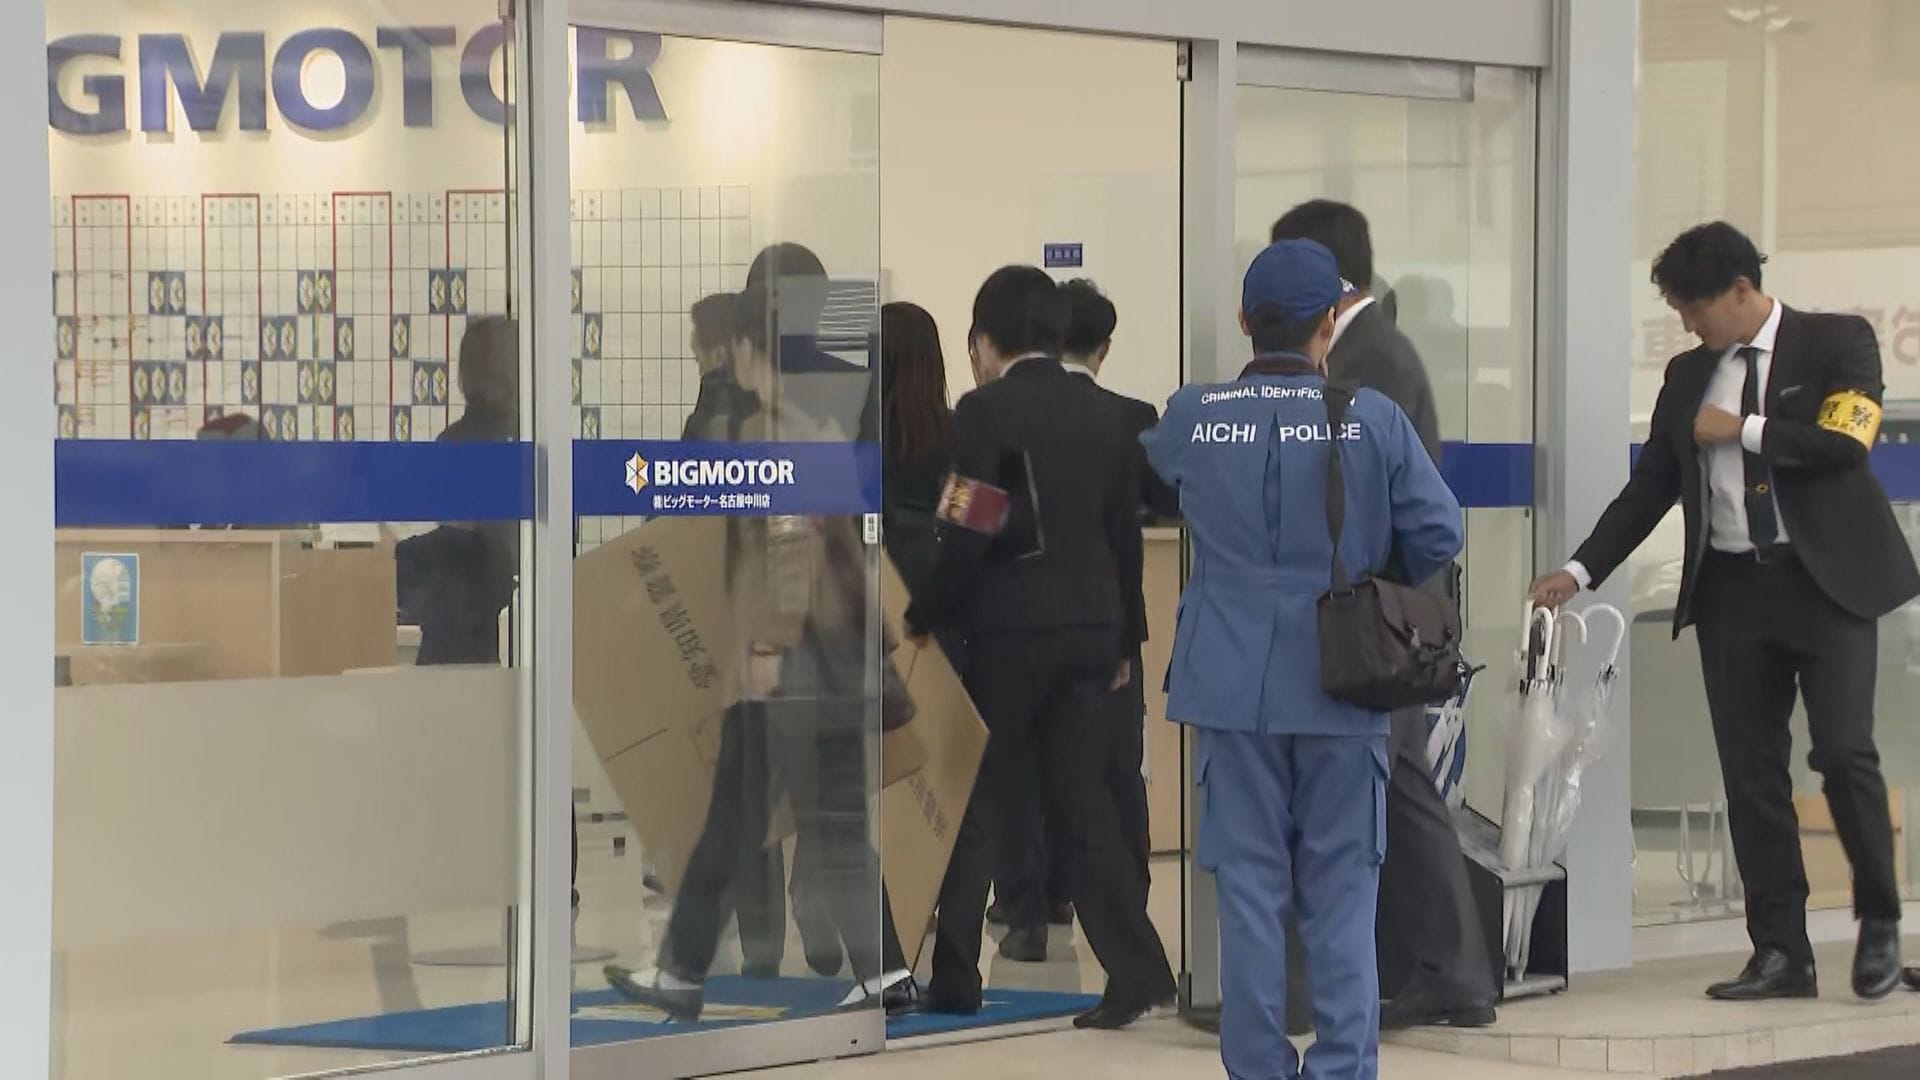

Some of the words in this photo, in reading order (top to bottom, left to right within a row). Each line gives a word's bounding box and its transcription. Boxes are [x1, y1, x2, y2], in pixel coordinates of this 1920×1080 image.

[1201, 385, 1258, 405] CRIMINAL
[1191, 422, 1257, 443] AICHI
[654, 459, 795, 487] BIGMOTOR
